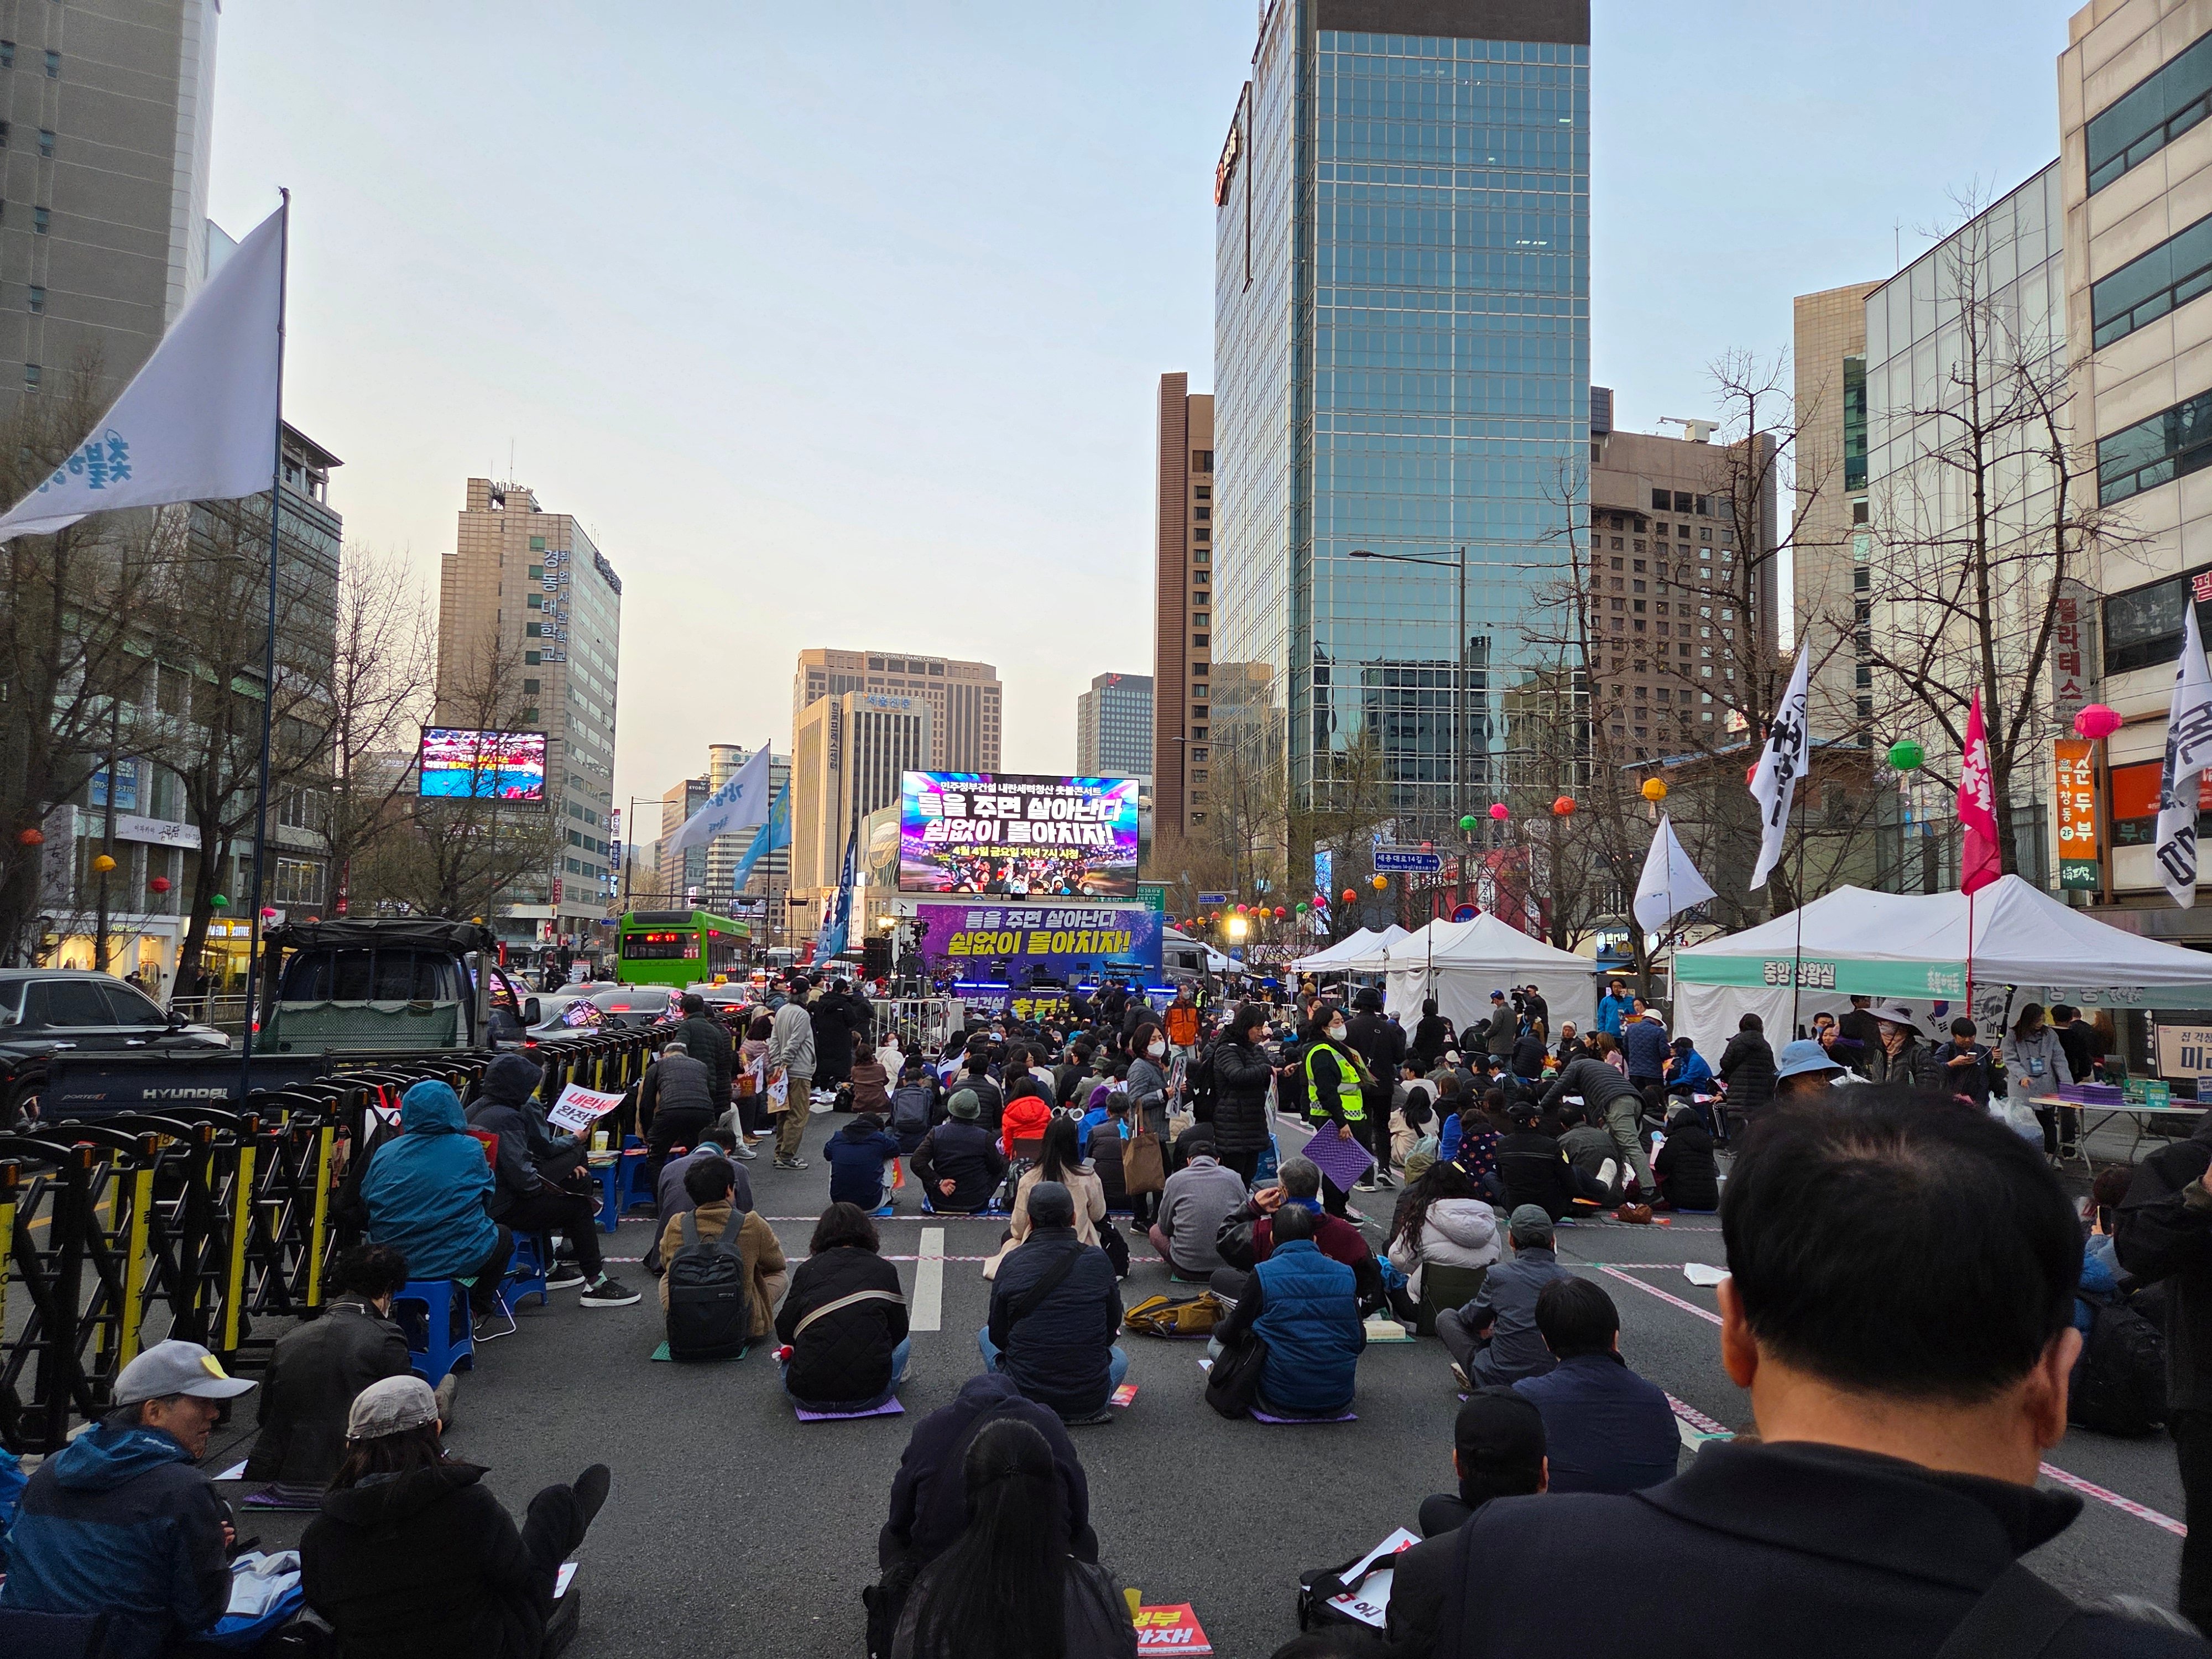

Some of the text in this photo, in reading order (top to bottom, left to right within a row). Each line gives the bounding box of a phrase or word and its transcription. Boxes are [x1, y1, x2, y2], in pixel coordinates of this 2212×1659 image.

[540, 550, 559, 661] 경동대학교
[556, 550, 569, 661] 취업사관학교
[2056, 598, 2083, 700] 필라테스
[868, 694, 911, 708] 서울신문
[830, 702, 839, 771] 한국프레스센터
[940, 781, 996, 794] 민주정부건설
[2060, 774, 2072, 822] 북창동
[2073, 759, 2094, 842] 순두부
[917, 792, 1123, 821] 틈을 주면 살아난다
[922, 818, 1116, 846] 쉼없이 몰아치자!
[972, 847, 989, 857] 4일
[990, 847, 1019, 857] 금요일
[1021, 848, 1041, 858] 저녁
[1378, 854, 1422, 864] 세종대로14길
[966, 910, 1117, 928] 틈을 주면 살아난다
[948, 930, 1131, 956] 쉼없이 몰아치자!
[1764, 961, 1837, 989] 중앙 상황실
[2180, 1032, 2191, 1042] 집
[143, 1087, 228, 1099] HYUNDAI
[556, 1105, 598, 1126] 완전청
